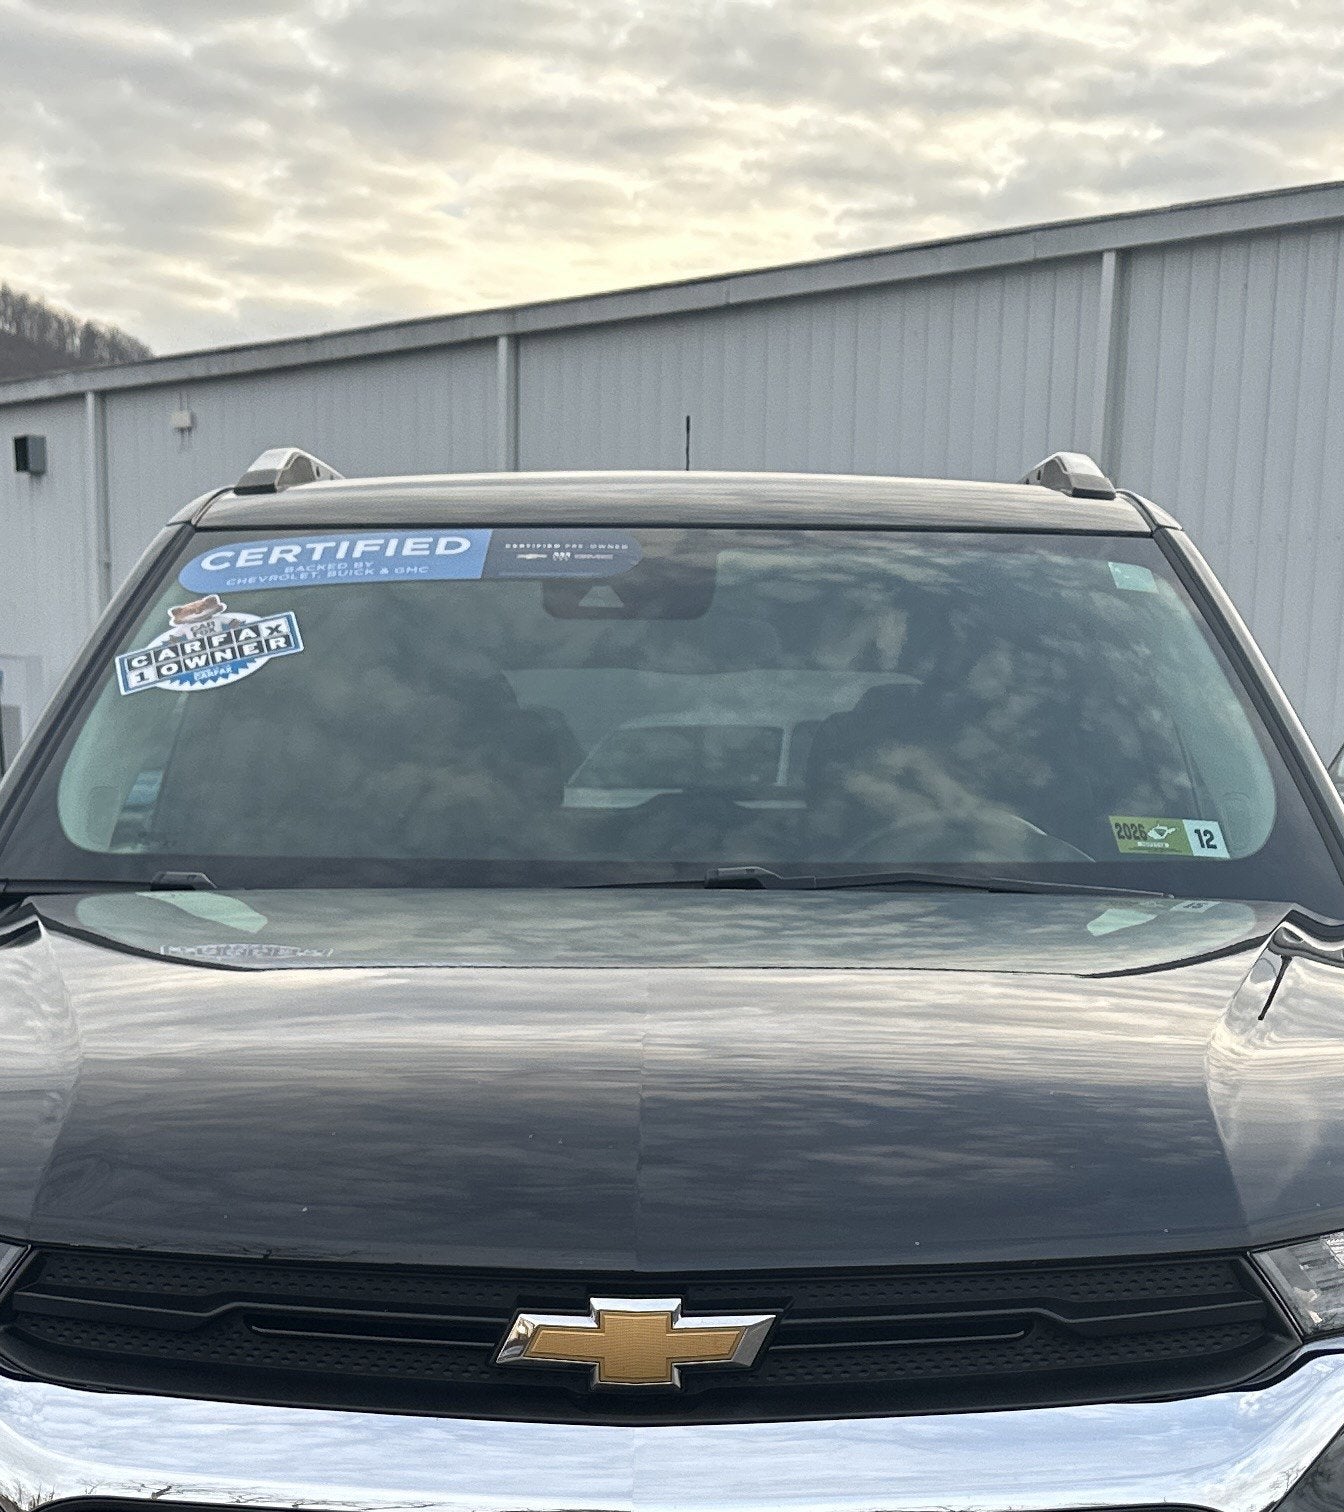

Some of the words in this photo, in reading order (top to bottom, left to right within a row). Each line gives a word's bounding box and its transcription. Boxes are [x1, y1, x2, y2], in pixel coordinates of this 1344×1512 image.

[200, 536, 471, 571] CERTIFIED
[284, 562, 349, 575] BACKED
[353, 561, 375, 571] BY
[326, 567, 375, 578] BUICK
[379, 566, 390, 575] &
[393, 565, 430, 575] GMC
[131, 622, 284, 669] CARFAX
[1114, 822, 1149, 841] 2026
[1193, 828, 1218, 850] 12
